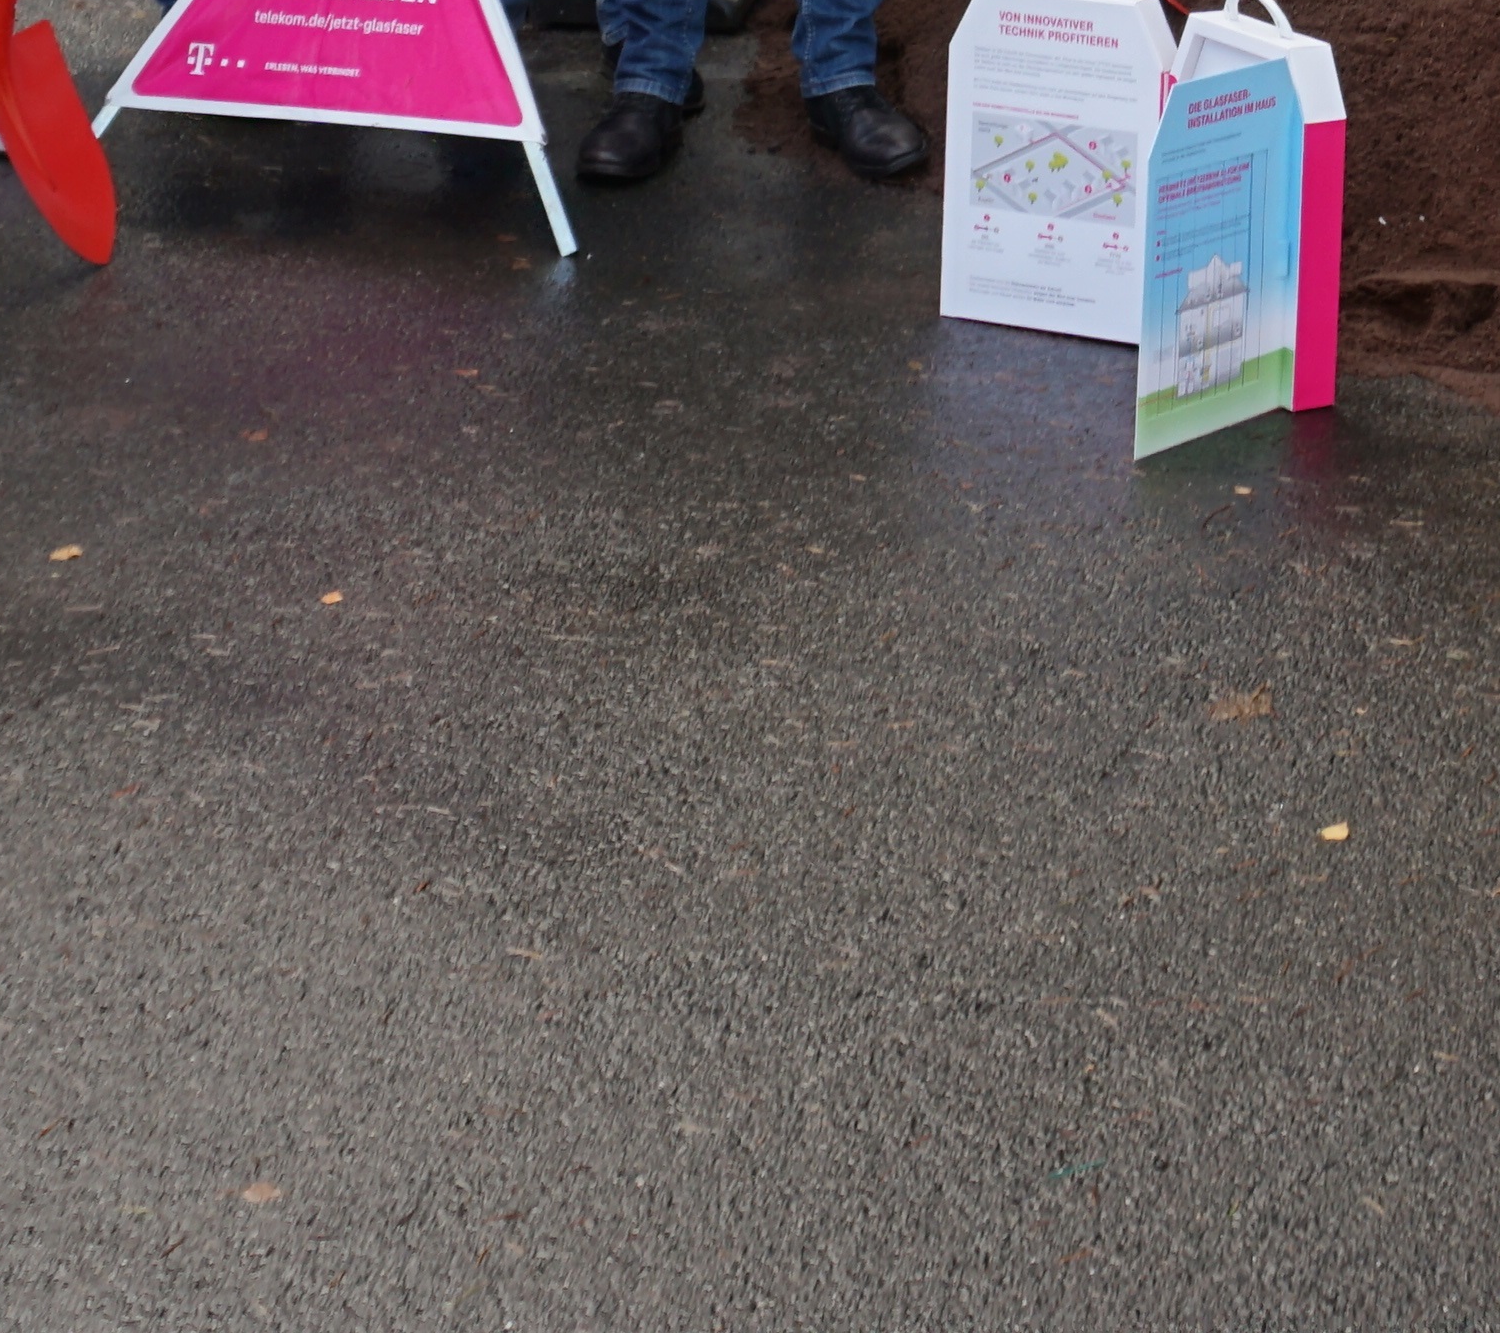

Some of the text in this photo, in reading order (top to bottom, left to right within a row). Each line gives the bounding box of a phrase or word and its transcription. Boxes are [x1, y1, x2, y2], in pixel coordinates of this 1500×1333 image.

[255, 9, 424, 36] telekom.de/jetzt-glasfaser
[999, 10, 1094, 32] VON INNOVATIVER
[999, 24, 1119, 48] TECHNIK PROFITIEREN
[1187, 96, 1276, 129] INSTALLATION IM HAUS
[1188, 101, 1202, 114] DIE
